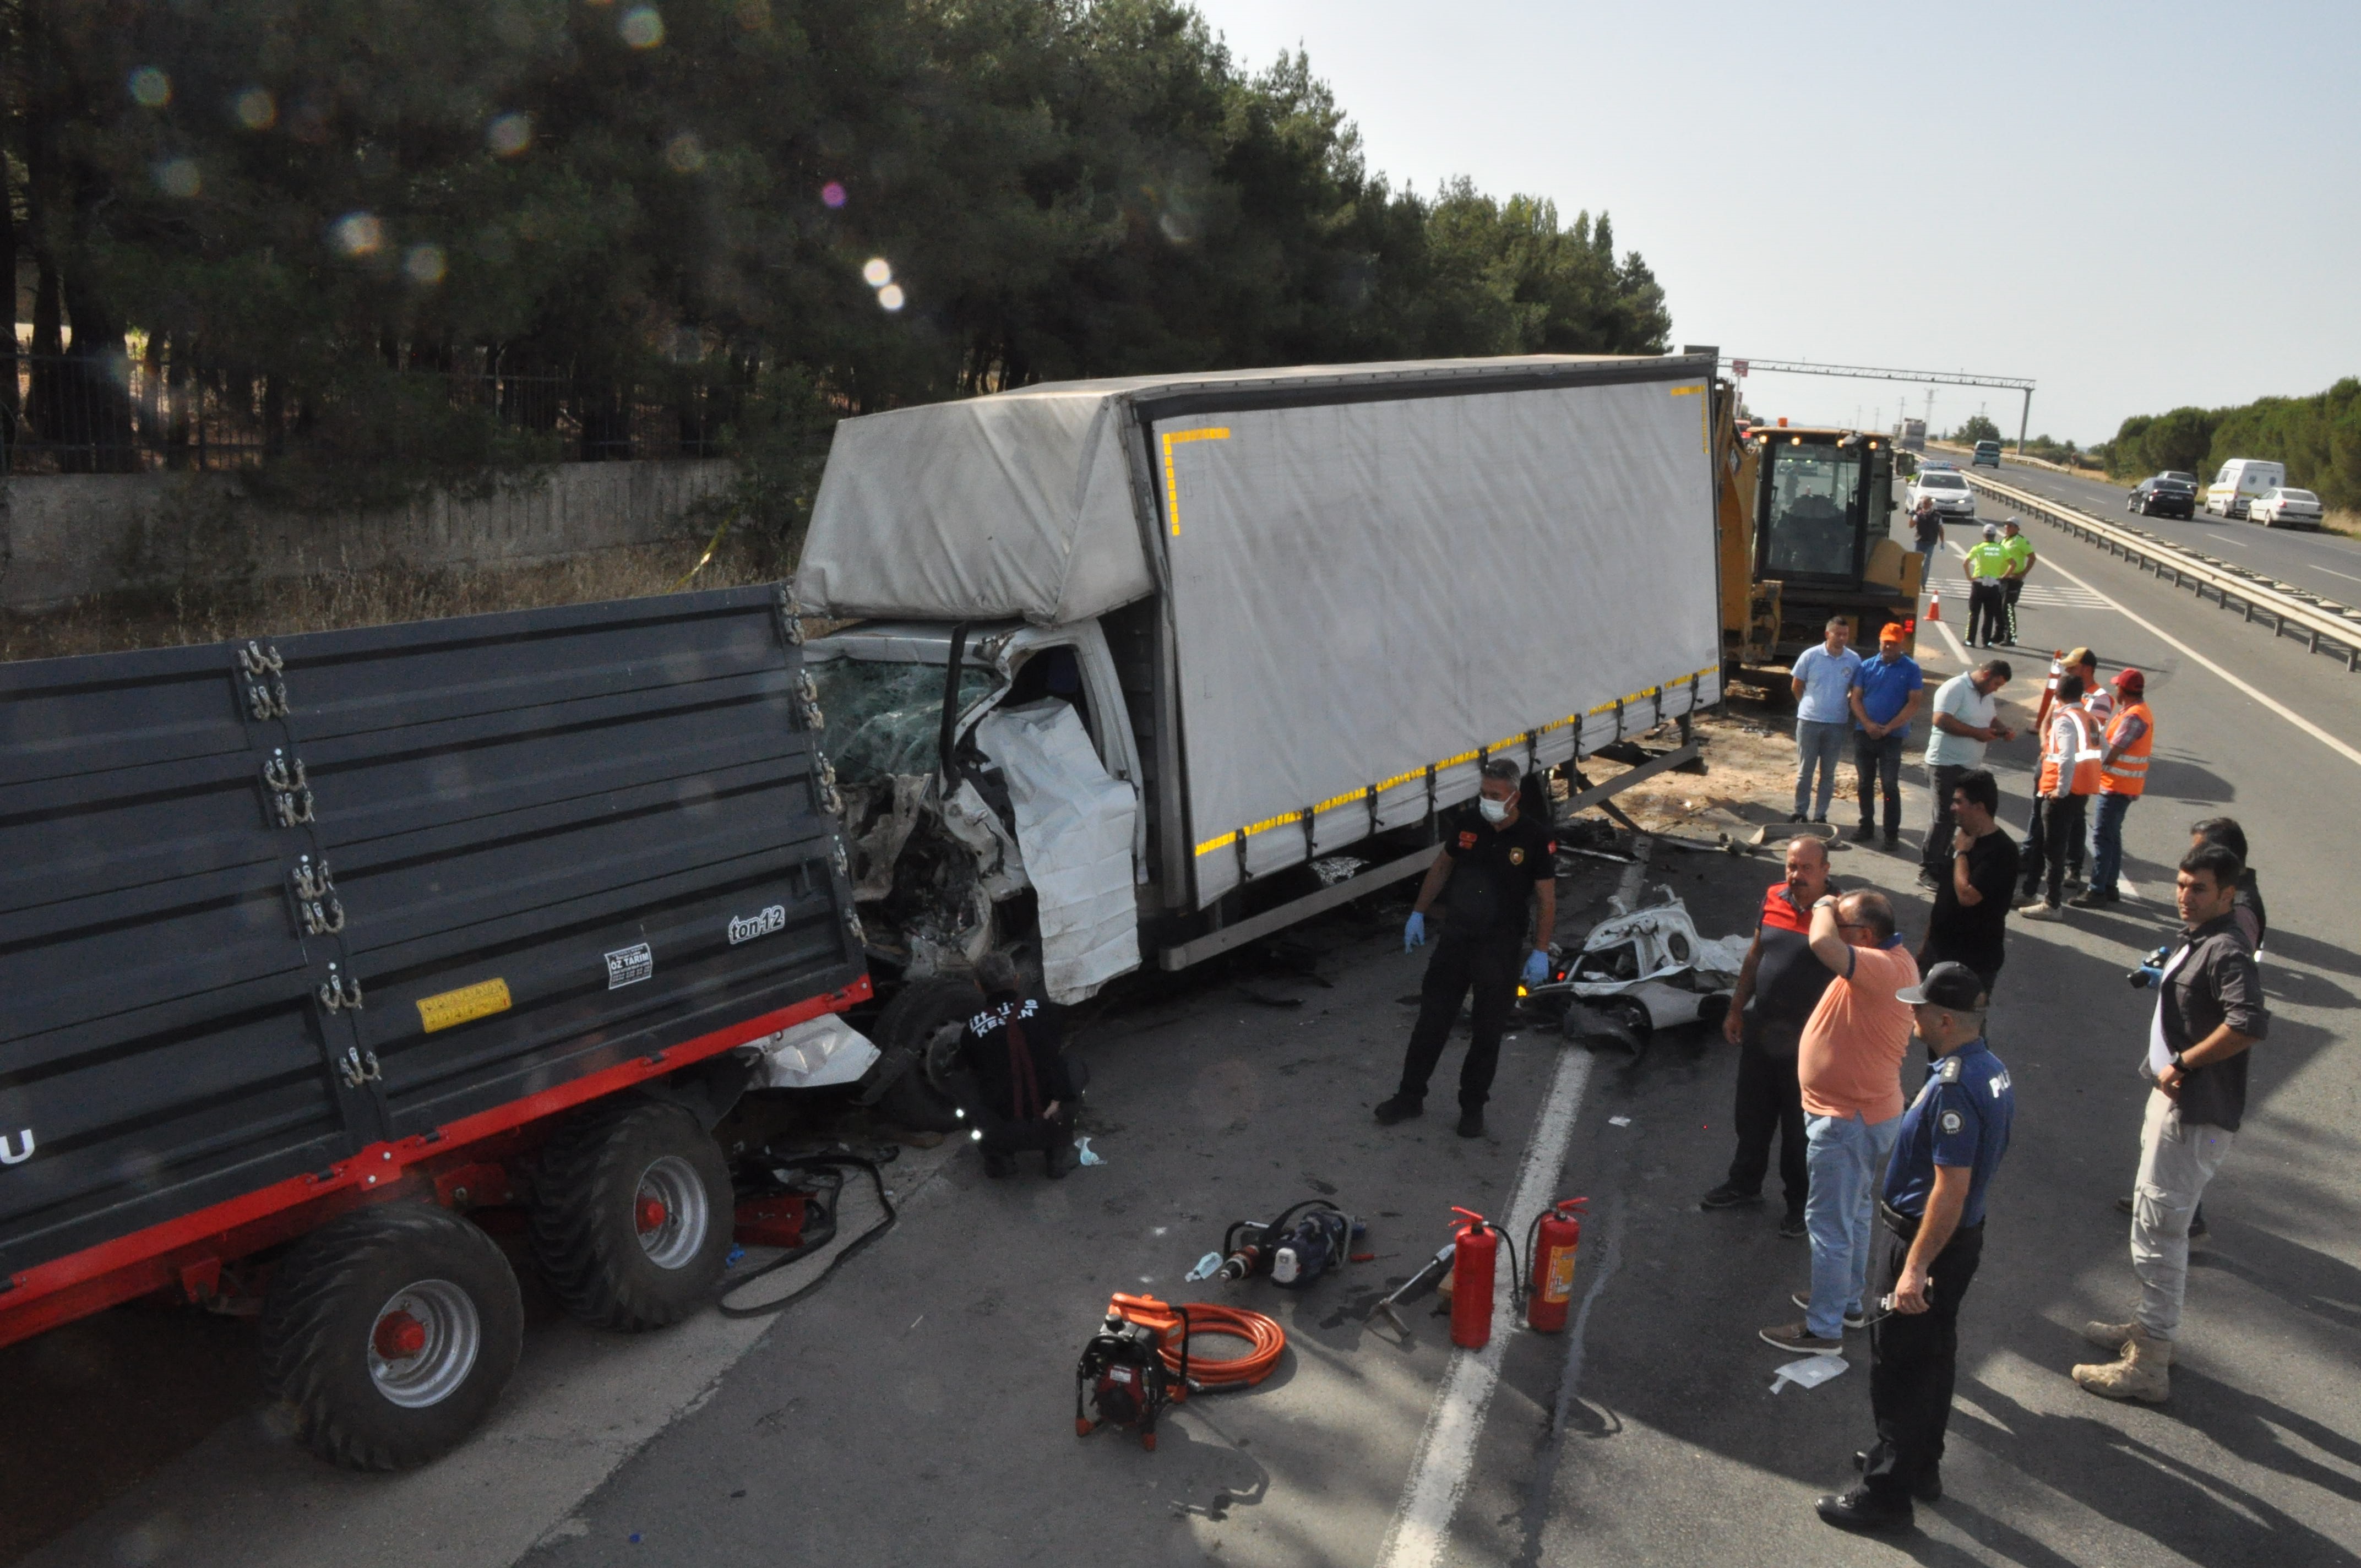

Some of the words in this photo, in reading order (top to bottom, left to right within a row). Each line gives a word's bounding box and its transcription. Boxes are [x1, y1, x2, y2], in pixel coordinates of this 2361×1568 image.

[731, 919, 759, 942] ton
[761, 907, 783, 932] 12
[623, 952, 649, 966] TARIM
